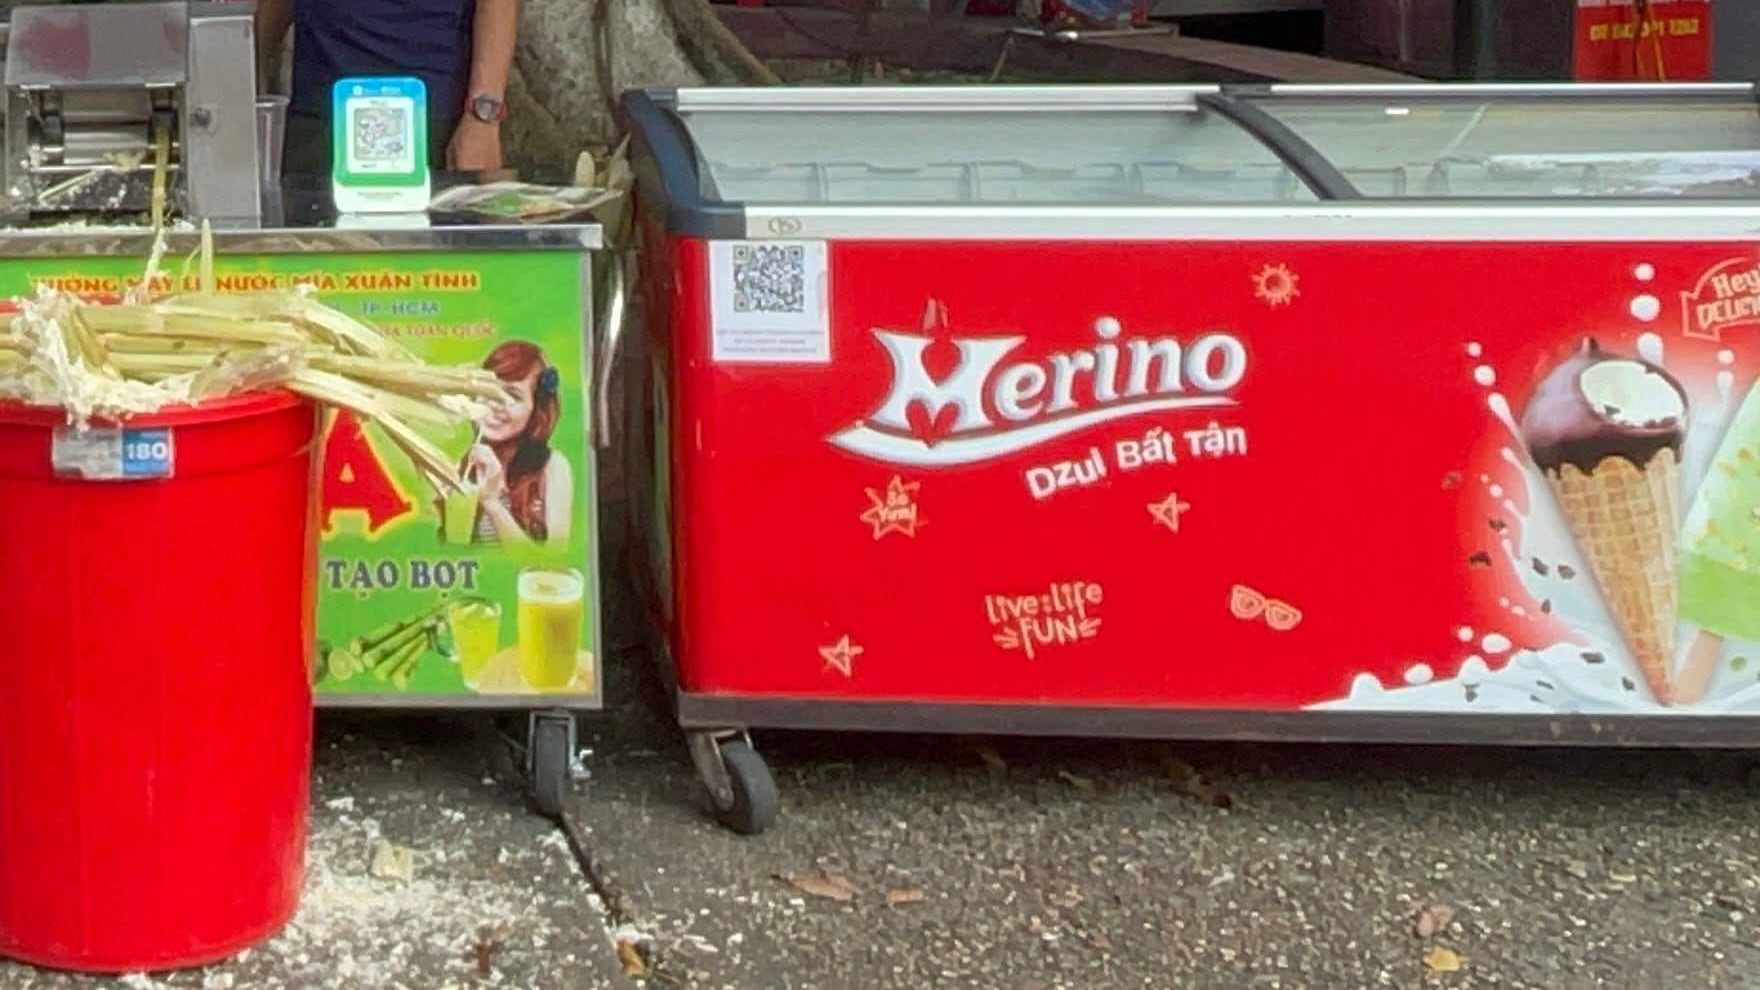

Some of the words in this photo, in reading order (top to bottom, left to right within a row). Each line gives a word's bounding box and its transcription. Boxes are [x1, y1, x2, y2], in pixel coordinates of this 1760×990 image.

[870, 315, 1247, 435] Merino
[126, 441, 169, 460] 180
[326, 559, 400, 598] TẠO
[409, 559, 480, 598] BỌT
